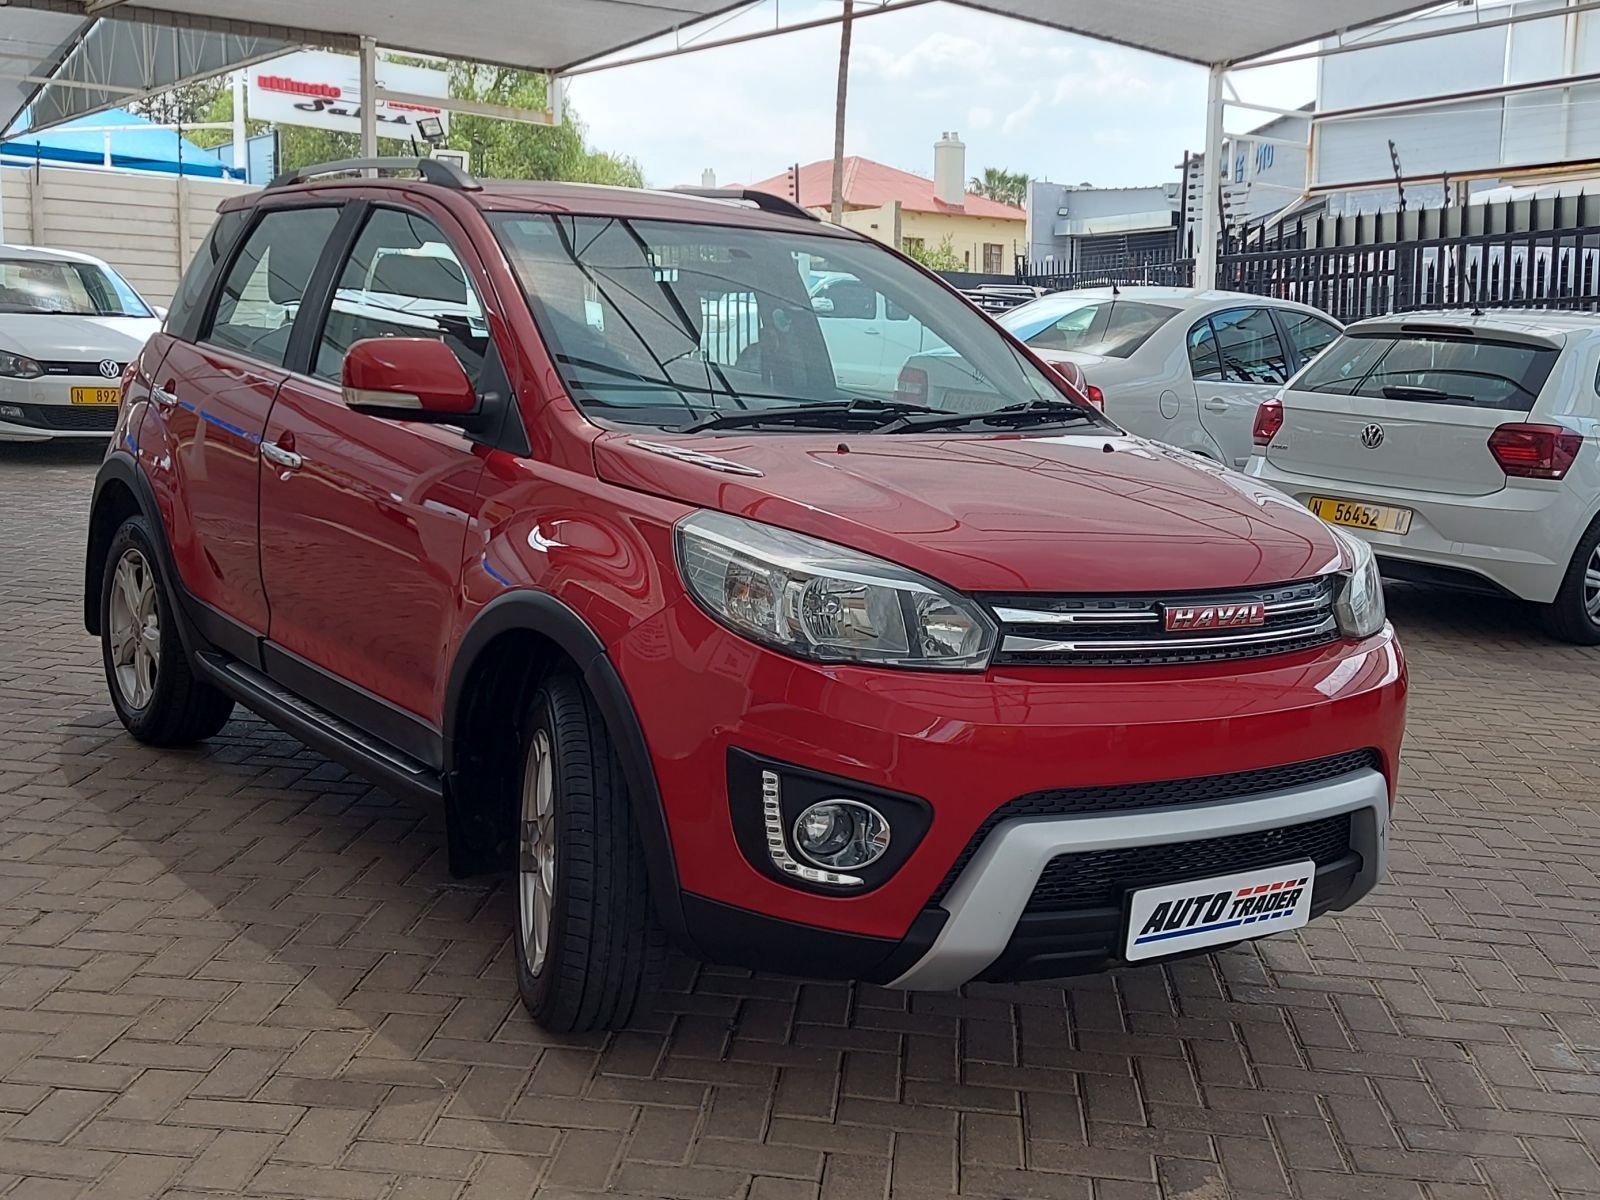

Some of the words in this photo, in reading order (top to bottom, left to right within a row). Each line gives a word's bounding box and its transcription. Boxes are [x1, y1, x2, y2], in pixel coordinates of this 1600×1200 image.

[258, 75, 341, 98] ultimate
[76, 390, 84, 402] N
[96, 390, 120, 402] 892
[1312, 501, 1322, 518] N
[1335, 503, 1380, 526] 56452
[1171, 605, 1264, 628] HAVAL
[1139, 891, 1233, 936] AUTO
[1228, 888, 1303, 919] TRADER
